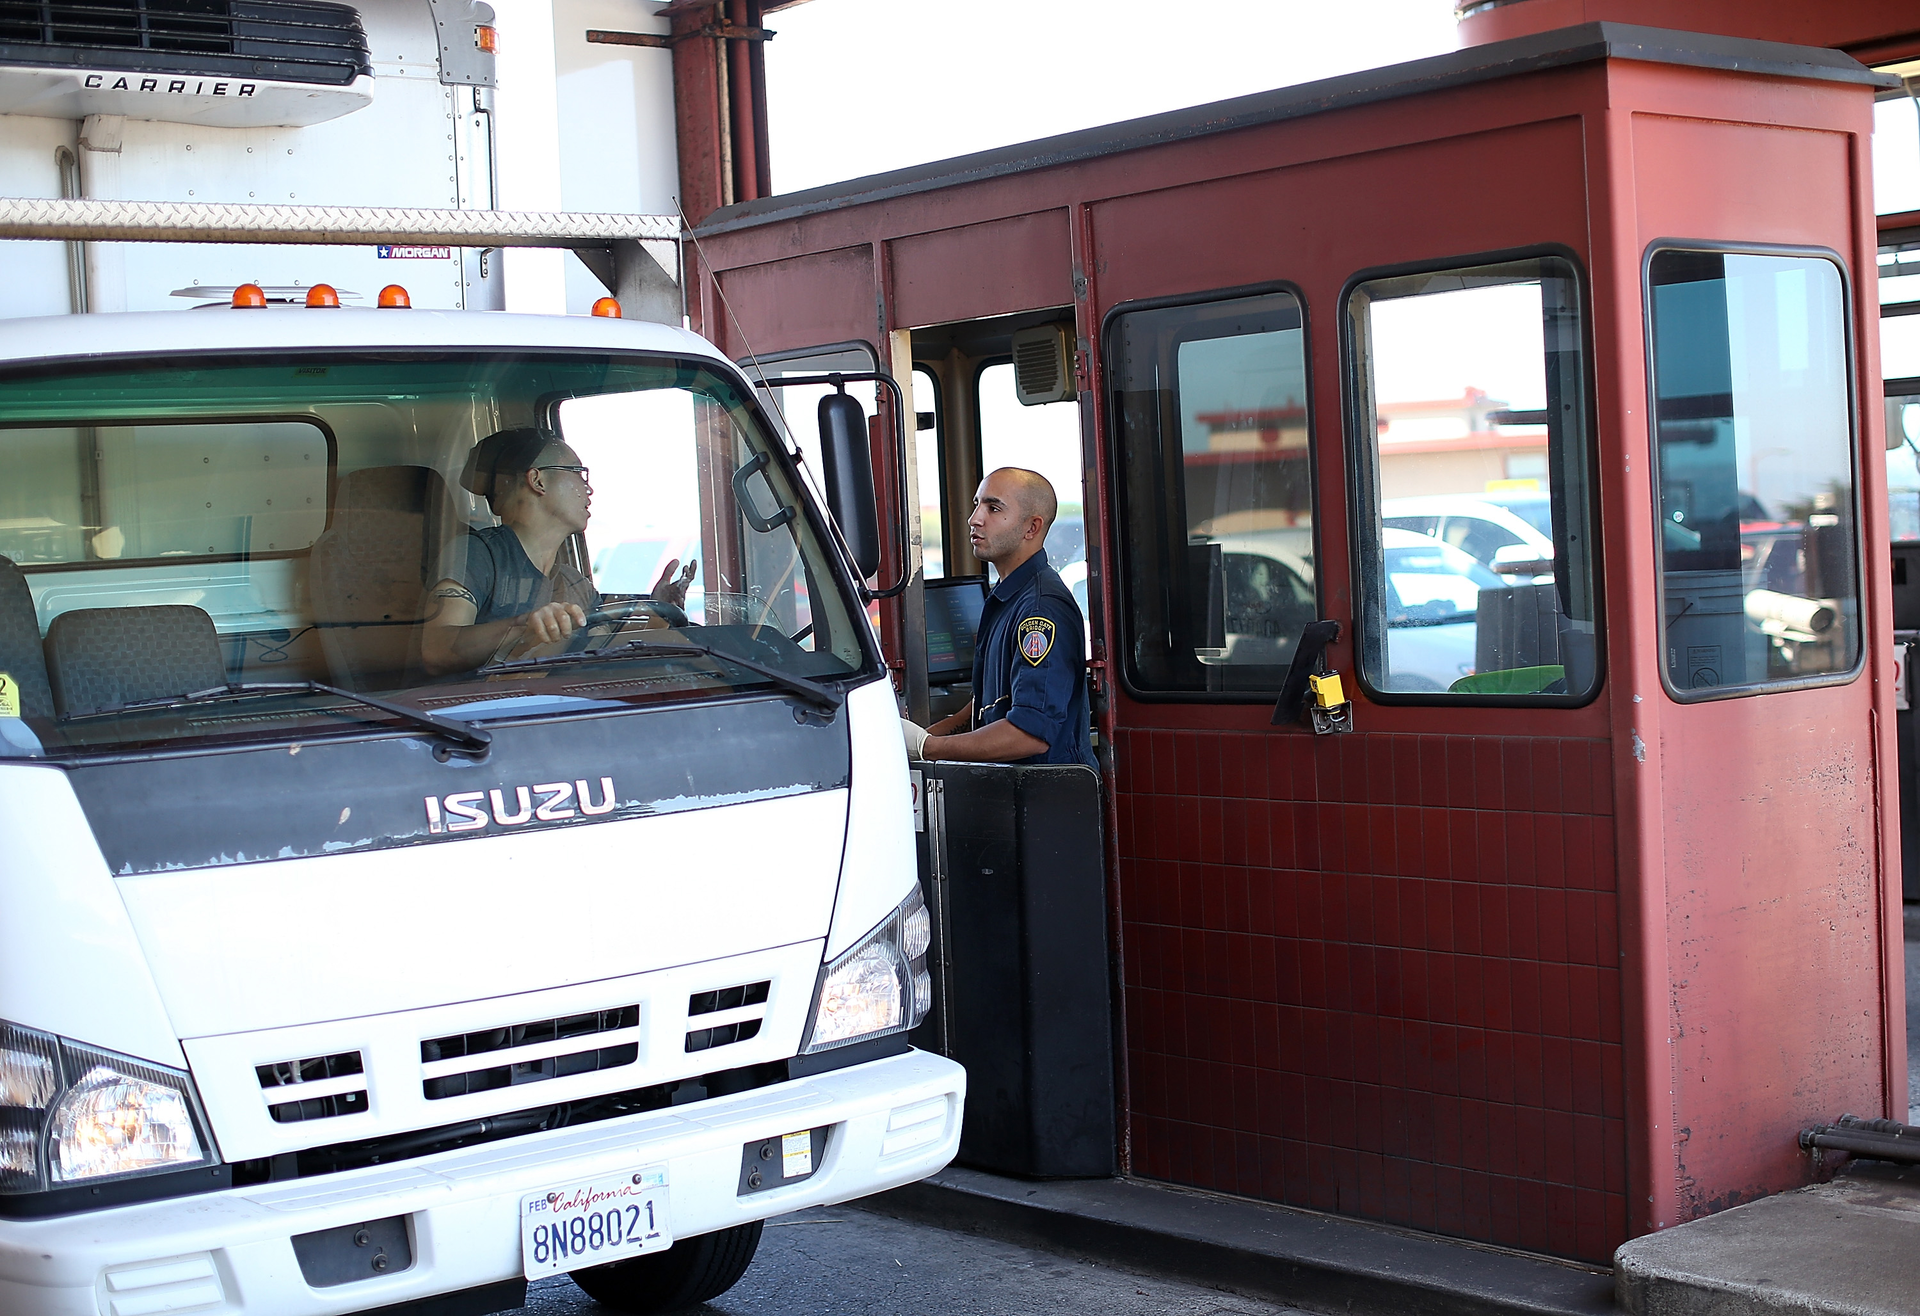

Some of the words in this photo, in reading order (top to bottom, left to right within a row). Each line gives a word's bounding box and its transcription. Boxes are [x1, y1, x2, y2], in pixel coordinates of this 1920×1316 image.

[84, 74, 256, 97] CARRIER
[391, 247, 449, 258] MORGAN
[1020, 620, 1039, 631] GOLDEN
[1039, 620, 1052, 631] GATE
[424, 776, 616, 834] ISUZU
[529, 1199, 547, 1213] FEB
[552, 1183, 642, 1213] California
[533, 1200, 661, 1263] 8N88021
